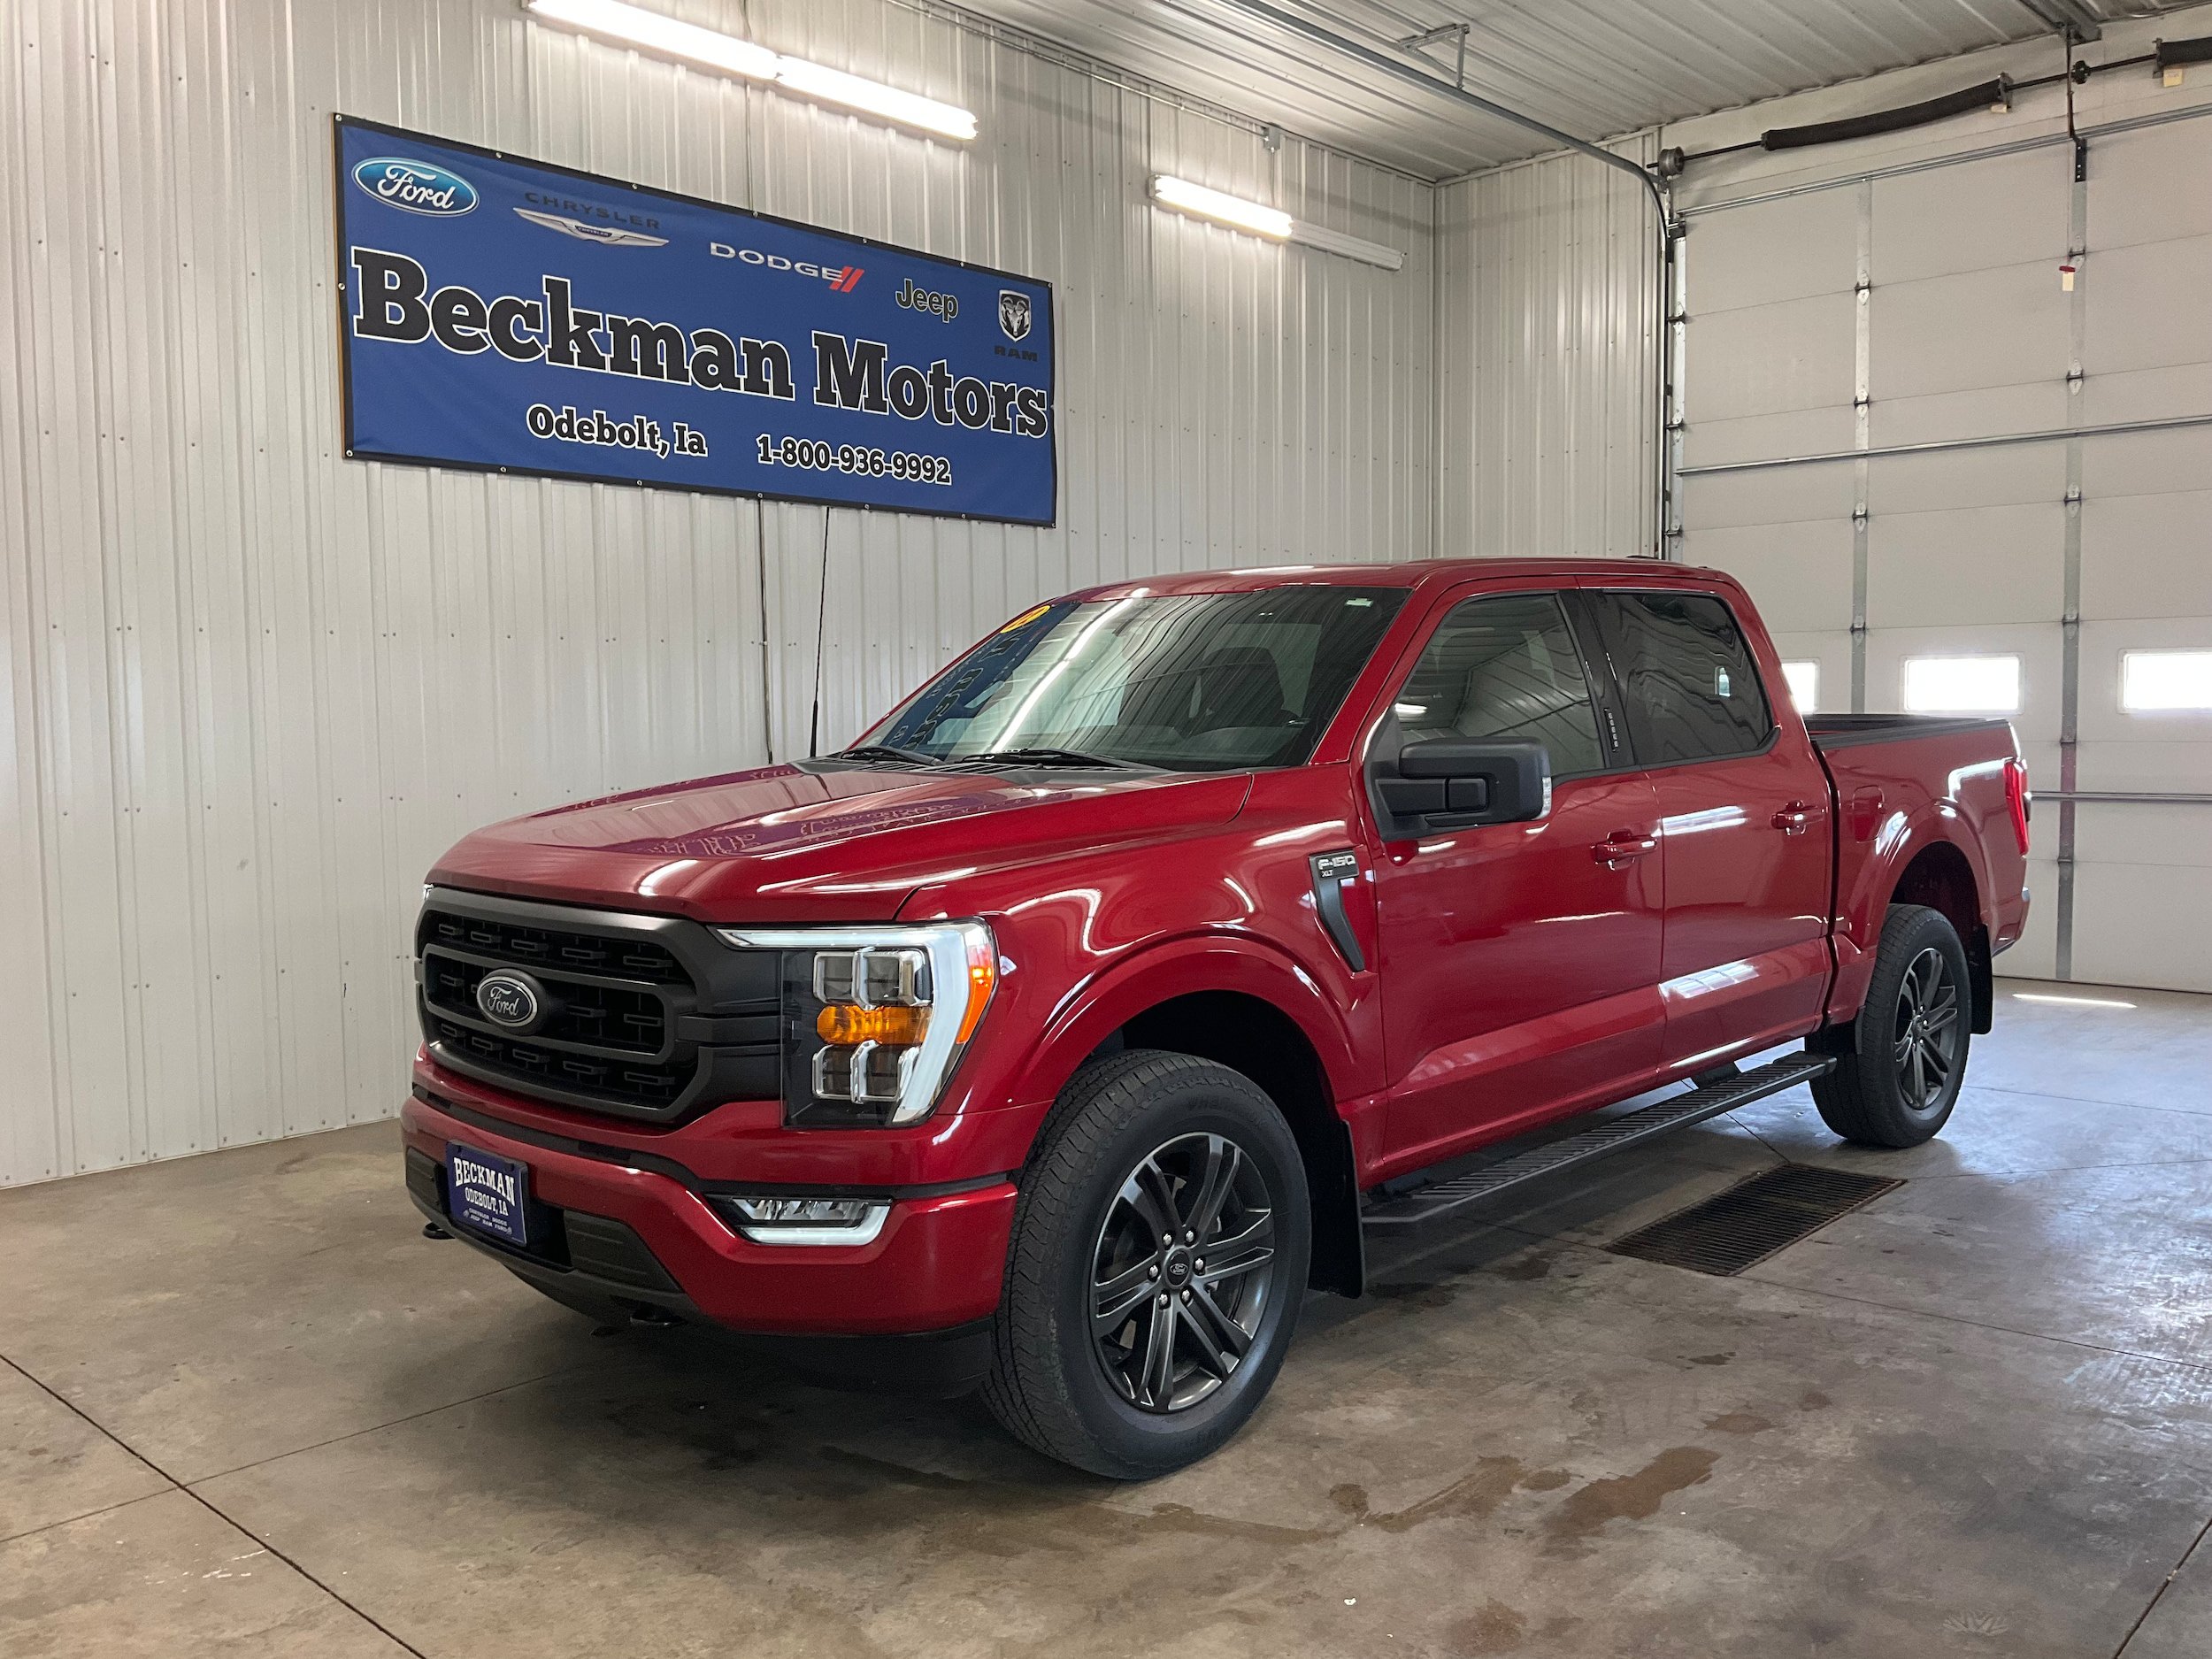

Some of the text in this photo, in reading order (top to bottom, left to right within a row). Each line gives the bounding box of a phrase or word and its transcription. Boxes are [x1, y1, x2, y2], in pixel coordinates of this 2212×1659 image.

[377, 164, 455, 211] Ford
[525, 192, 661, 230] CHRYSLER
[710, 242, 843, 280] DODGE
[895, 278, 958, 323] Jeep
[351, 245, 1048, 439] Beckman Motors
[994, 345, 1038, 362] RAM
[526, 403, 708, 460] Odebolt, Ia
[756, 433, 952, 486] 1-800-936-9992
[1317, 855, 1356, 870] F-150
[488, 987, 519, 1016] Ford
[454, 1157, 515, 1206] BECKMAN
[465, 1187, 509, 1217] ODEBOLT, IA
